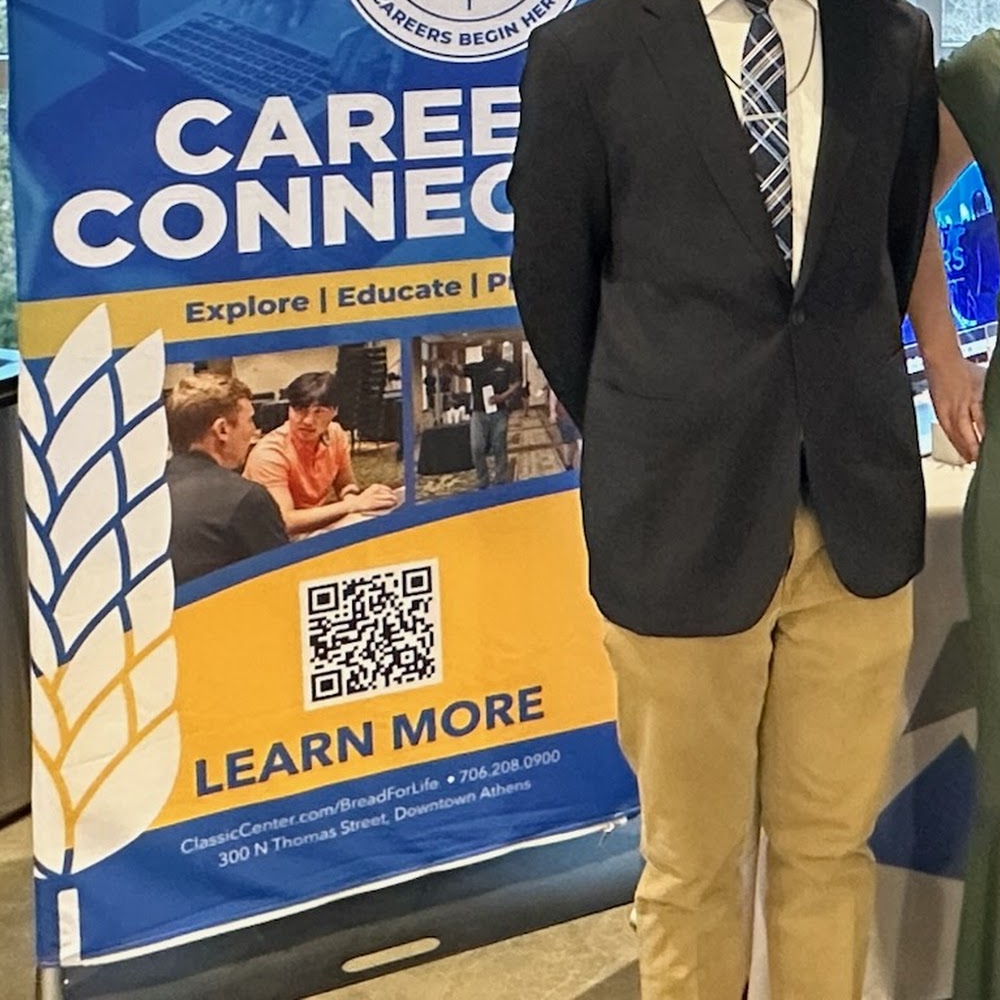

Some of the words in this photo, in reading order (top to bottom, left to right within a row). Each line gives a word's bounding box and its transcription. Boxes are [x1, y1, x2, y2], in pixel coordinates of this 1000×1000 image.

[458, 21, 520, 46] BEGIN
[154, 85, 522, 176] CAREE
[51, 161, 515, 269] CONNEC
[185, 295, 310, 325] Explore
[337, 278, 462, 308] Educate
[194, 721, 375, 798] LEARN
[392, 685, 546, 751] MORE
[179, 777, 440, 855] ClassicCenter.com/BreadForLife
[459, 748, 562, 784] 706.208.0900
[217, 844, 251, 868] 300
[253, 840, 269, 857] N
[271, 826, 338, 853] Thomas
[339, 813, 391, 838] Street,
[393, 791, 477, 823] Downtown
[479, 778, 533, 799] Athens
